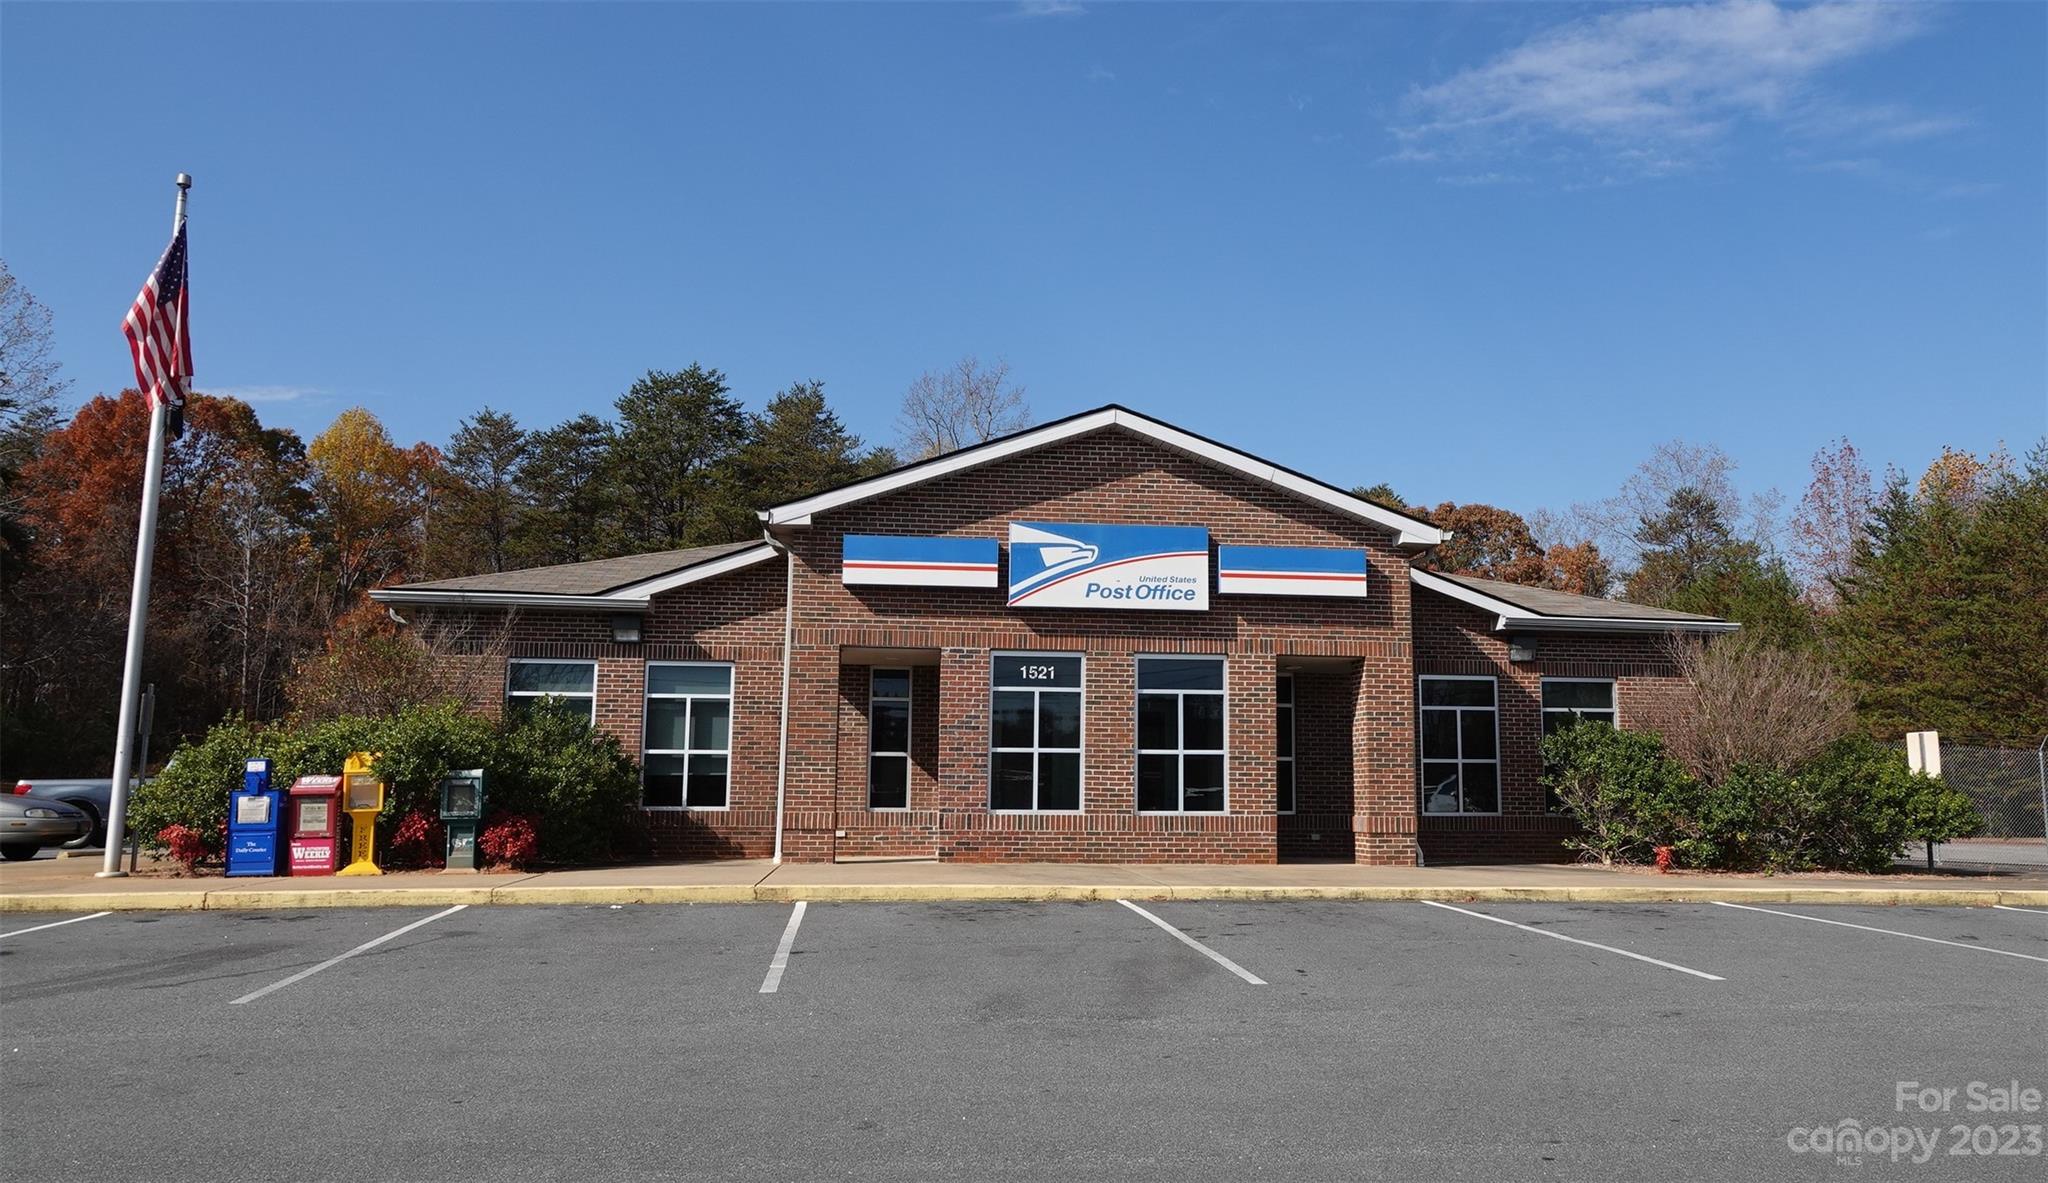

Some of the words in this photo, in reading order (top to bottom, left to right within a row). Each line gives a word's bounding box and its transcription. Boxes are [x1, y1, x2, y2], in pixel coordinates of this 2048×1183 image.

[1139, 575, 1167, 583] United
[1169, 576, 1197, 584] States
[1085, 583, 1133, 599] Post
[1135, 584, 1196, 601] Office
[1020, 665, 1055, 679] 1521
